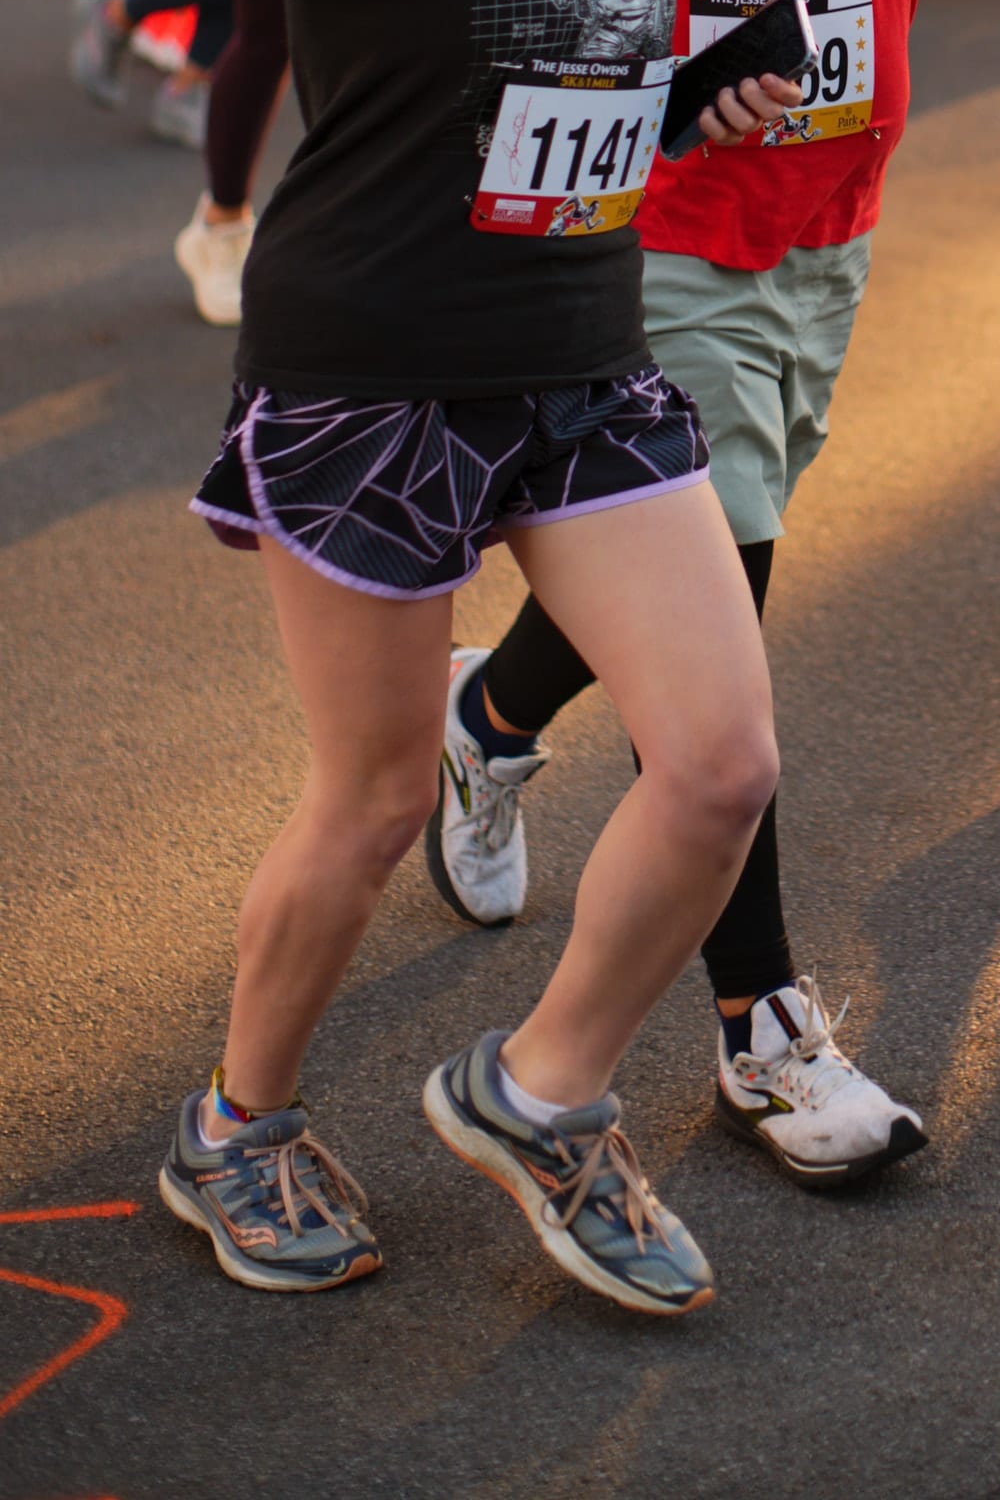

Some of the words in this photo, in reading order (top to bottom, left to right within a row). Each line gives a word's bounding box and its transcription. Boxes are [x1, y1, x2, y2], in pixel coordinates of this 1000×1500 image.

[532, 59, 555, 74] THE
[556, 61, 588, 76] JESSE
[590, 63, 631, 76] OWENS
[837, 116, 858, 129] Park
[529, 116, 643, 191] 1141
